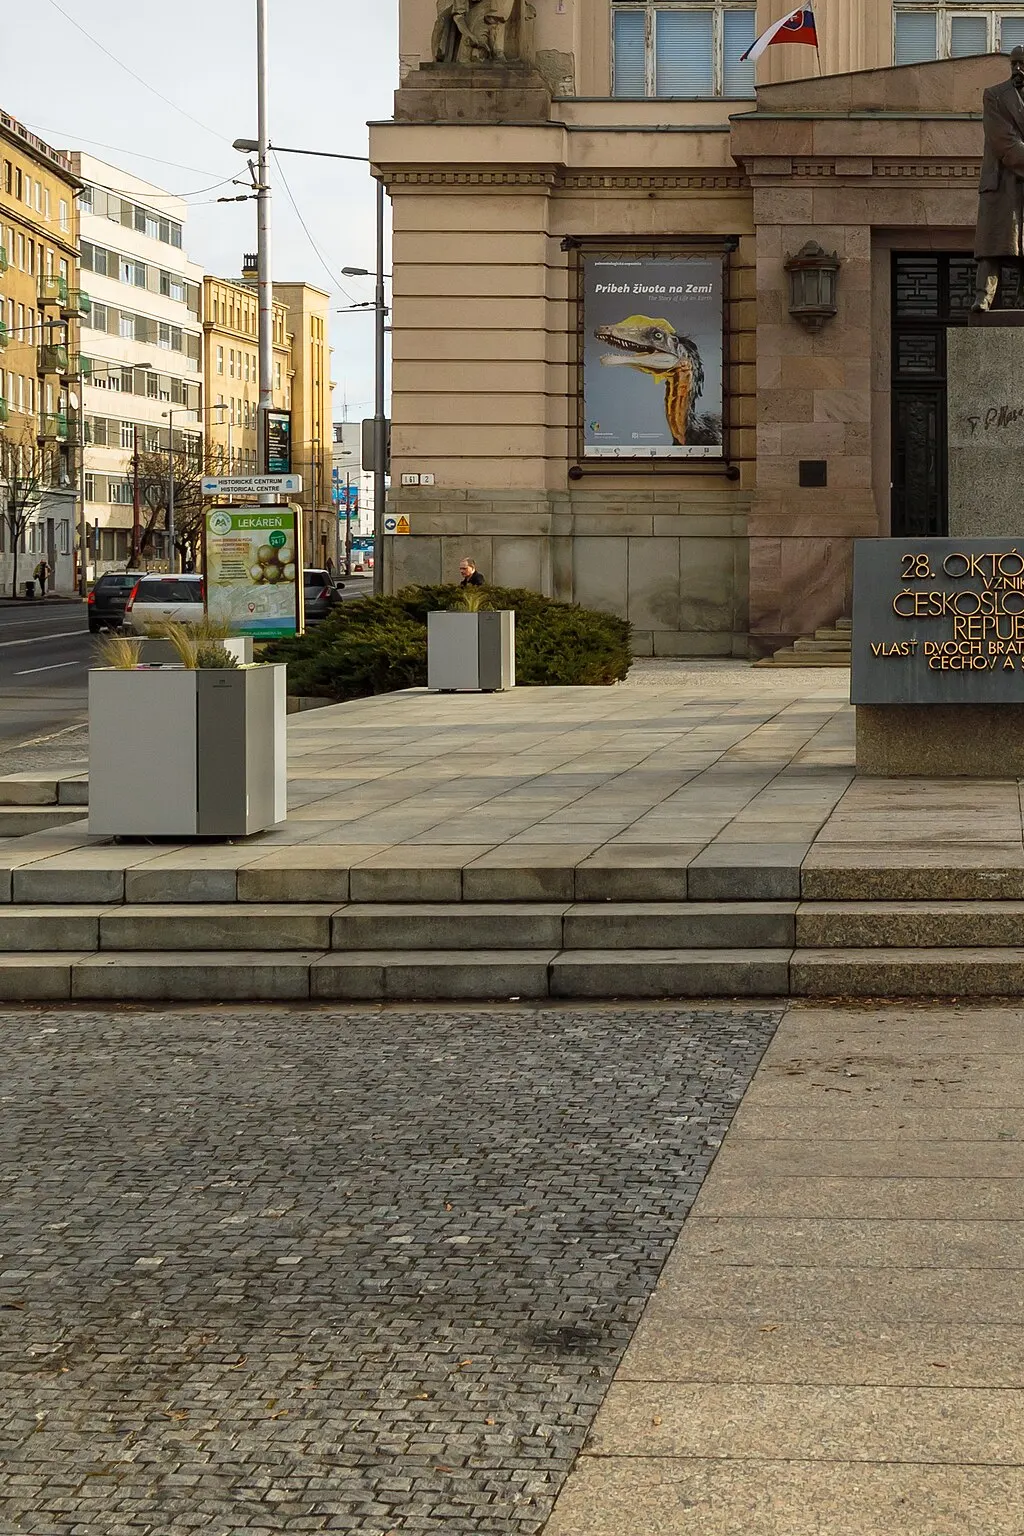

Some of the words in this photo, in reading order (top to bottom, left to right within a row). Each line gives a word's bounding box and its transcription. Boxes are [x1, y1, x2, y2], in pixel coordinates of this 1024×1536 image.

[633, 283, 666, 294] života
[669, 285, 683, 293] na
[686, 283, 713, 293] Zemi
[238, 516, 282, 528] LEKÁREŇ
[901, 553, 936, 578] 28.
[870, 639, 918, 656] VLASŤ
[924, 641, 982, 656] DVOCH
[929, 652, 997, 670] ČECHOV
[1003, 655, 1015, 670] A
